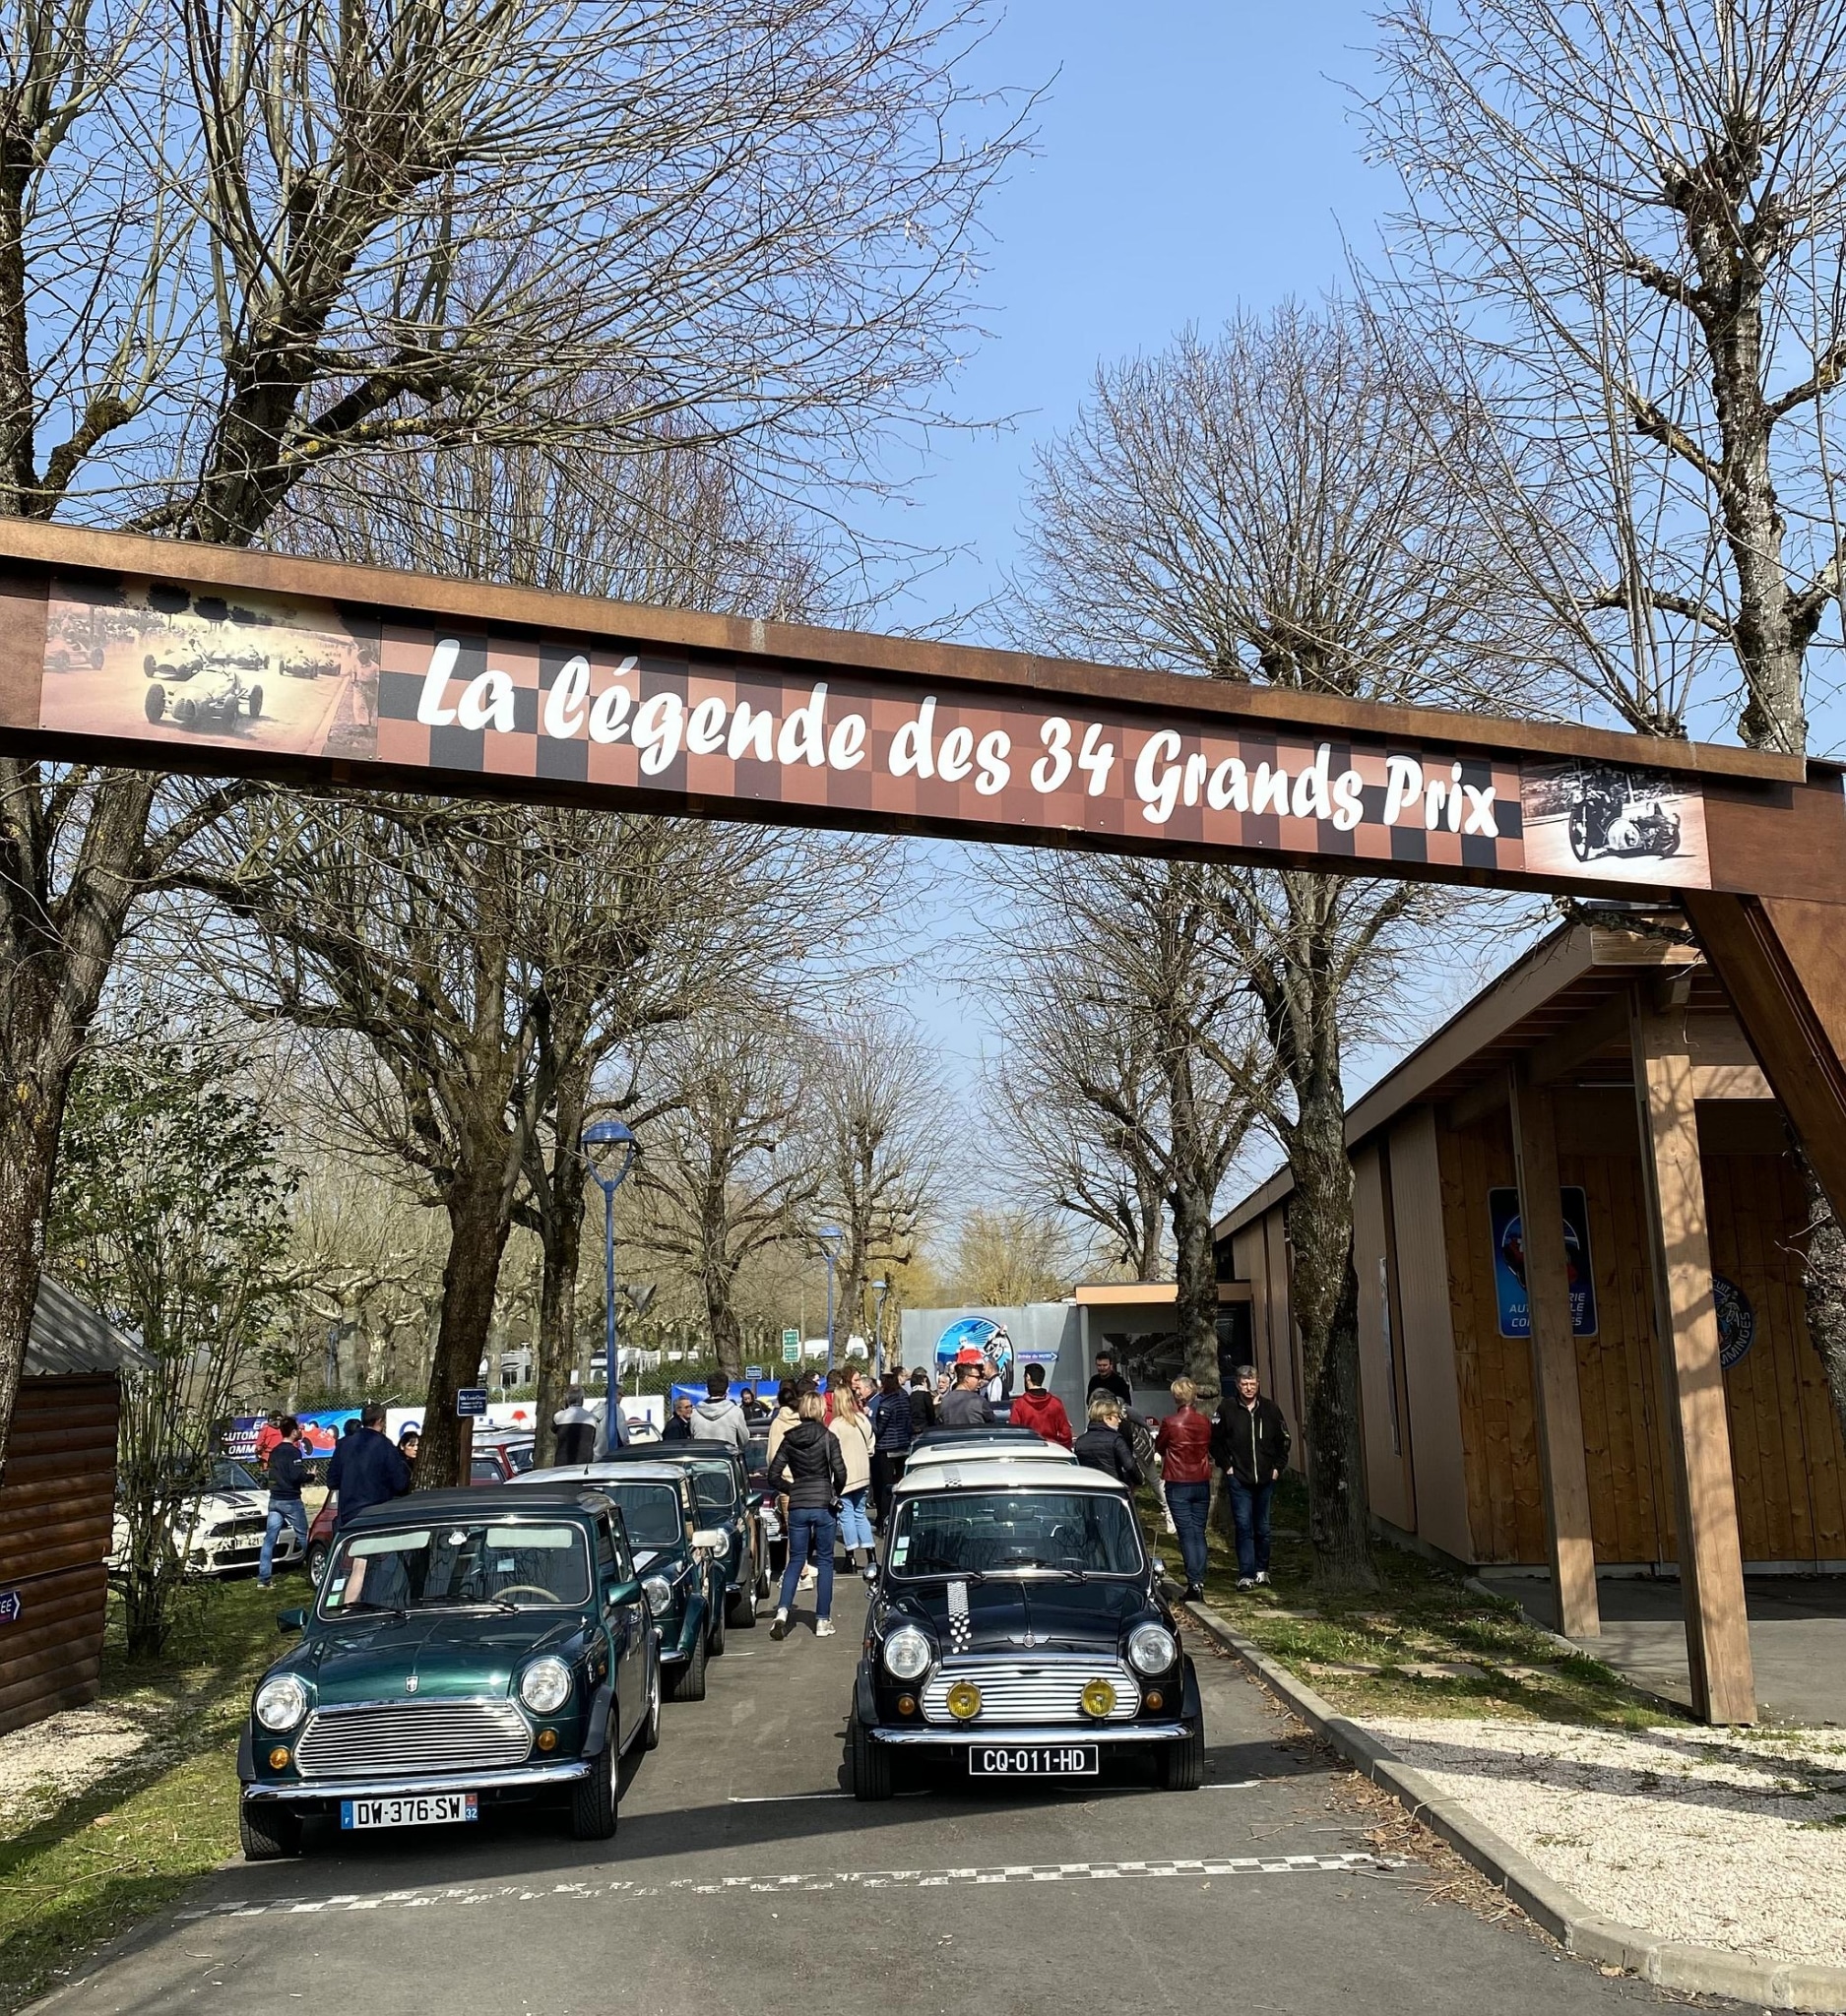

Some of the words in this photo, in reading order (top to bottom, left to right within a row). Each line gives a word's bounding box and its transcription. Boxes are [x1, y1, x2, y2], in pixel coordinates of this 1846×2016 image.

[417, 639, 515, 733] La
[543, 655, 866, 776] légende
[888, 696, 1011, 794] des
[1030, 717, 1114, 796] 34
[1134, 729, 1364, 831] Grands
[1383, 755, 1499, 838] Prix
[984, 1750, 1085, 1772] CQ-011-HD
[357, 1796, 460, 1825] DW-376-SW
[466, 1808, 477, 1819] 32
